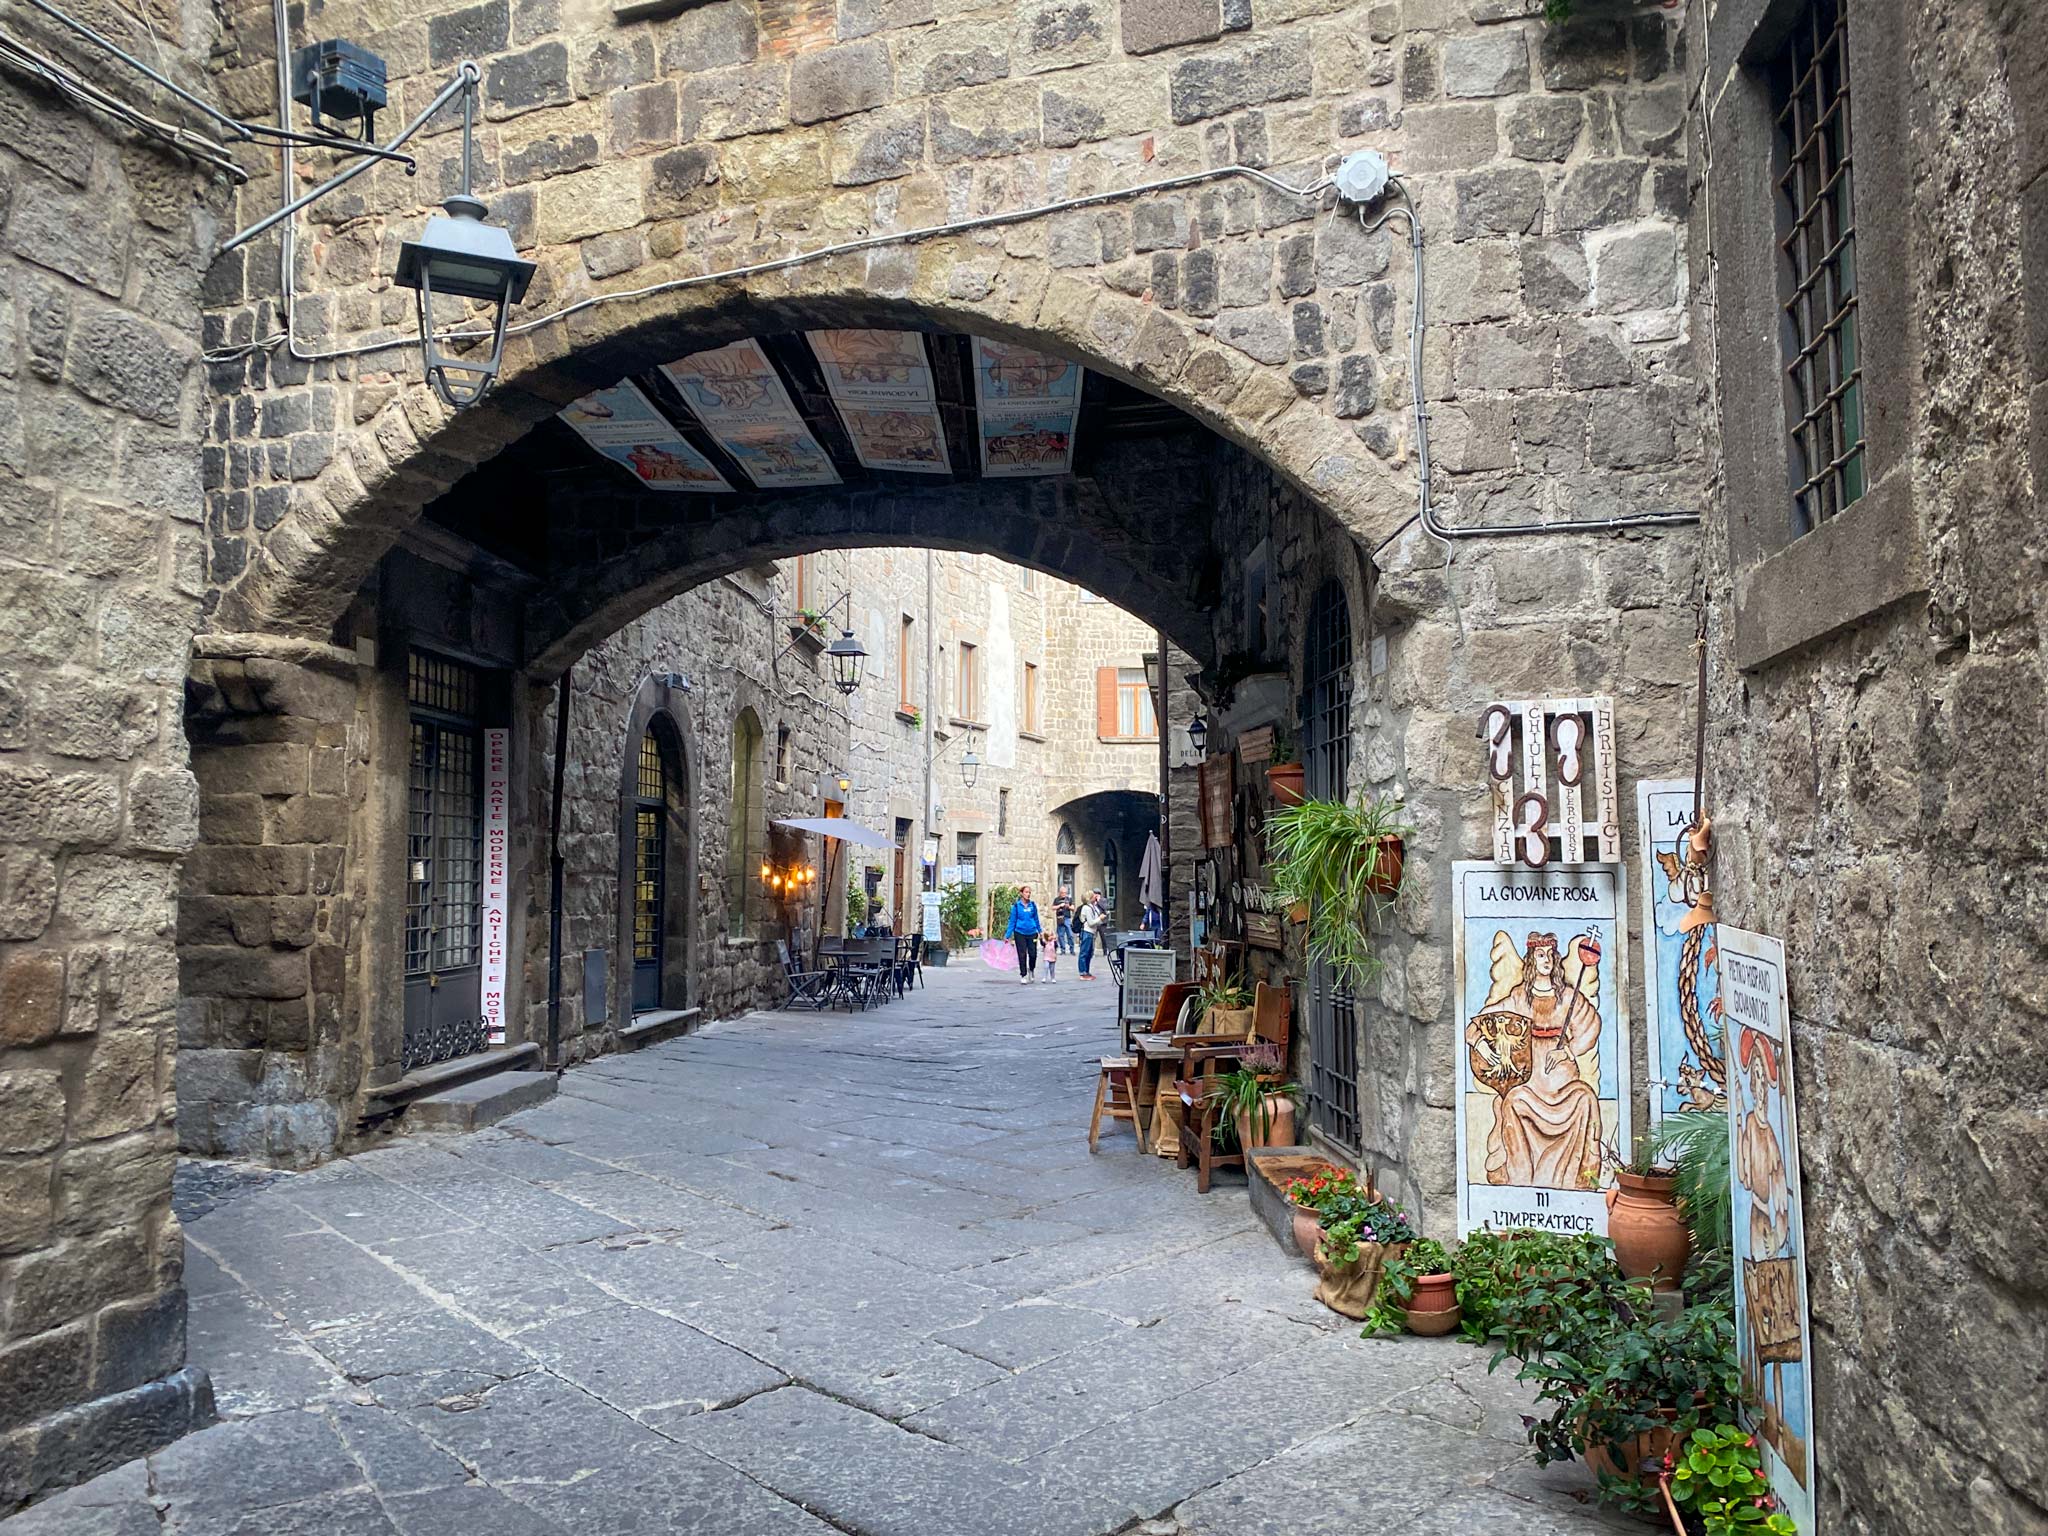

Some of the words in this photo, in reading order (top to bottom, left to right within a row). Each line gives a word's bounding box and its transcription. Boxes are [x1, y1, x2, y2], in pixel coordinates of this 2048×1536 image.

[490, 733, 504, 771] OPERE
[1529, 707, 1541, 789] CHIULLI
[491, 781, 506, 820] D'ARTE
[1599, 710, 1618, 855] ARTISTICI
[1497, 781, 1512, 863] CINZIA
[1566, 788, 1578, 862] PERCORSI
[1667, 810, 1688, 826] LA
[490, 829, 504, 884] MODERNE
[1480, 886, 1499, 901] LA
[1500, 885, 1561, 901] GIOVANE
[1561, 886, 1600, 901] ROSA
[489, 909, 502, 964] ANTICHE
[487, 992, 500, 1039] MOSTE
[1493, 1210, 1594, 1231] L'IMPERATRICE
